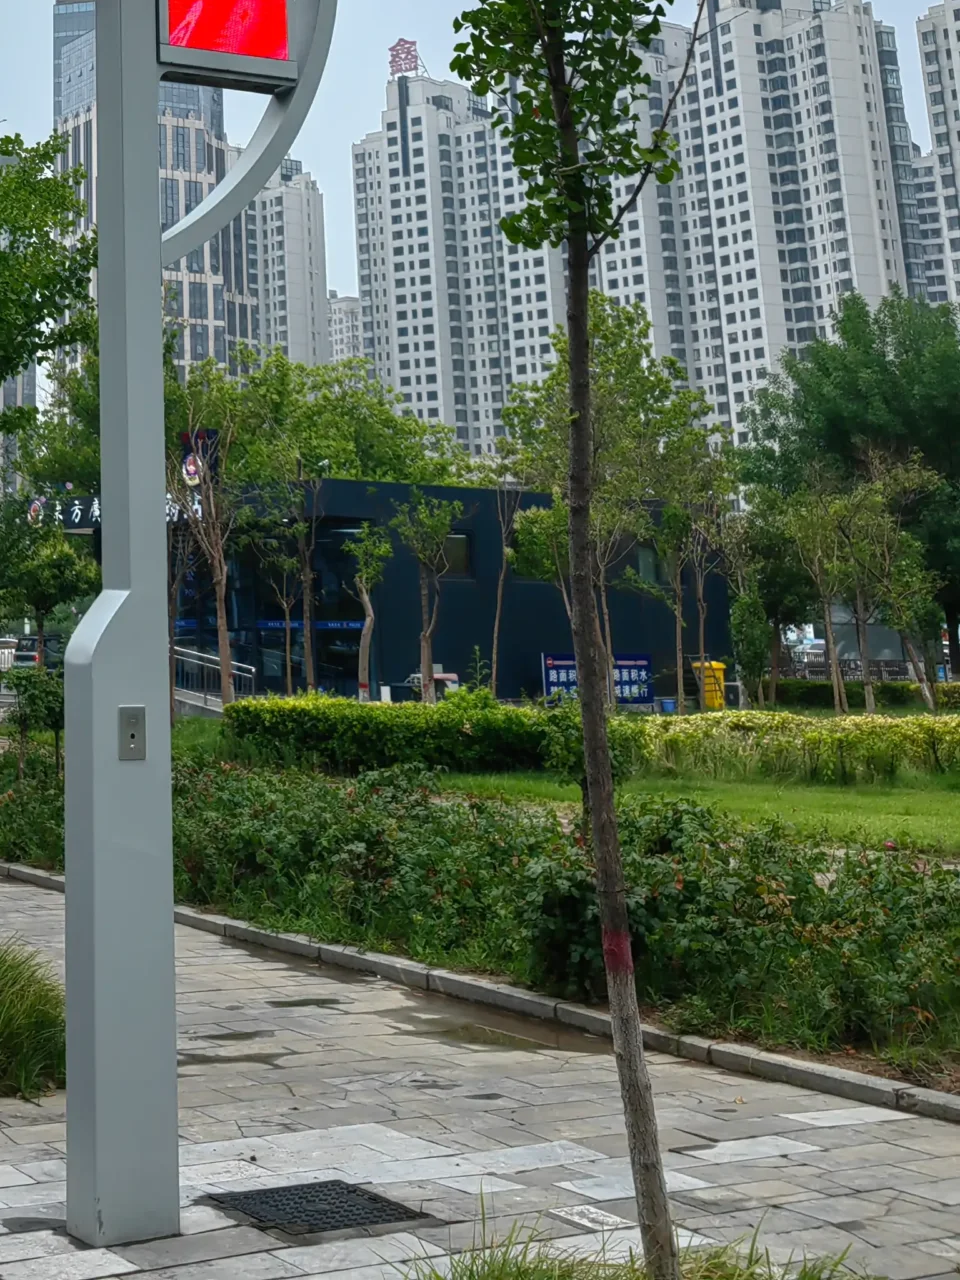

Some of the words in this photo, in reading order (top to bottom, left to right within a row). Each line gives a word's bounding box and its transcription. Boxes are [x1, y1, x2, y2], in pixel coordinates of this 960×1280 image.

[388, 38, 418, 76] 鑫
[549, 669, 578, 682] 路面积
